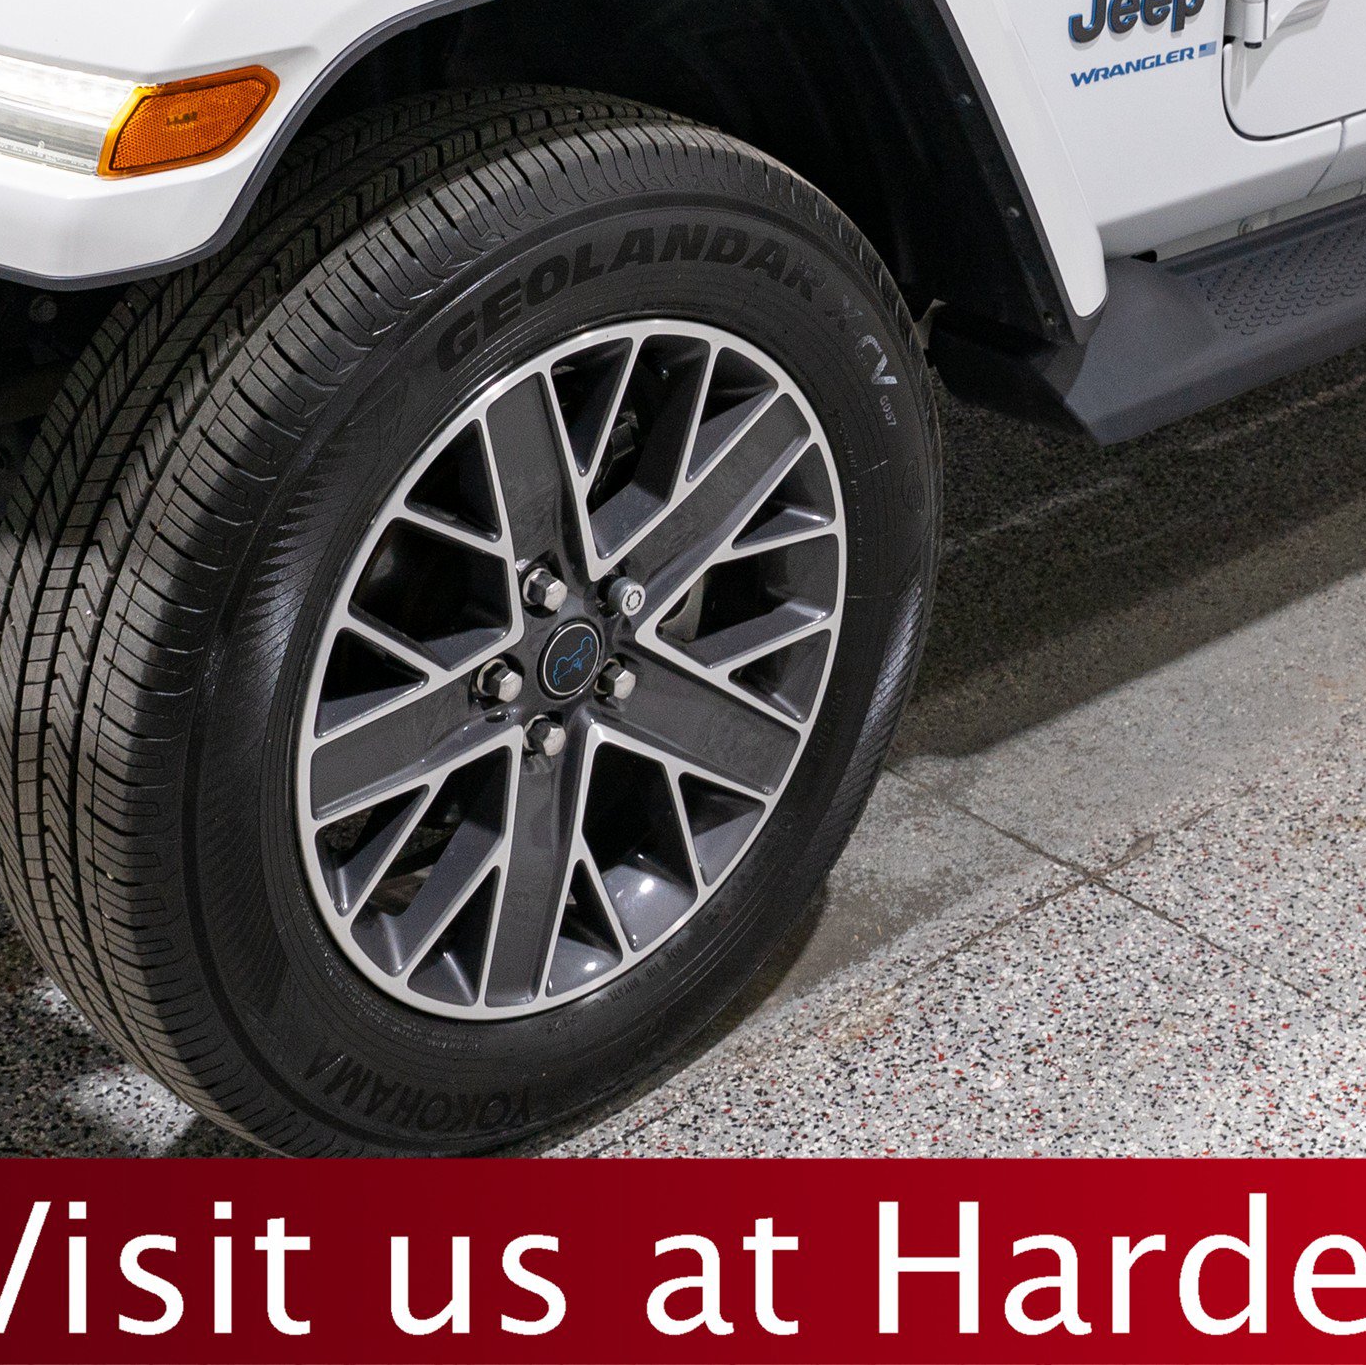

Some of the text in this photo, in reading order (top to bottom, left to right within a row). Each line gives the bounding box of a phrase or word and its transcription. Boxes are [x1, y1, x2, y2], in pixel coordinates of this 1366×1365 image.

[1070, 46, 1195, 88] WRANGLER
[436, 223, 825, 372] GEOLANDAR
[878, 394, 898, 427] G057
[302, 1045, 534, 1132] YOKOHAMA
